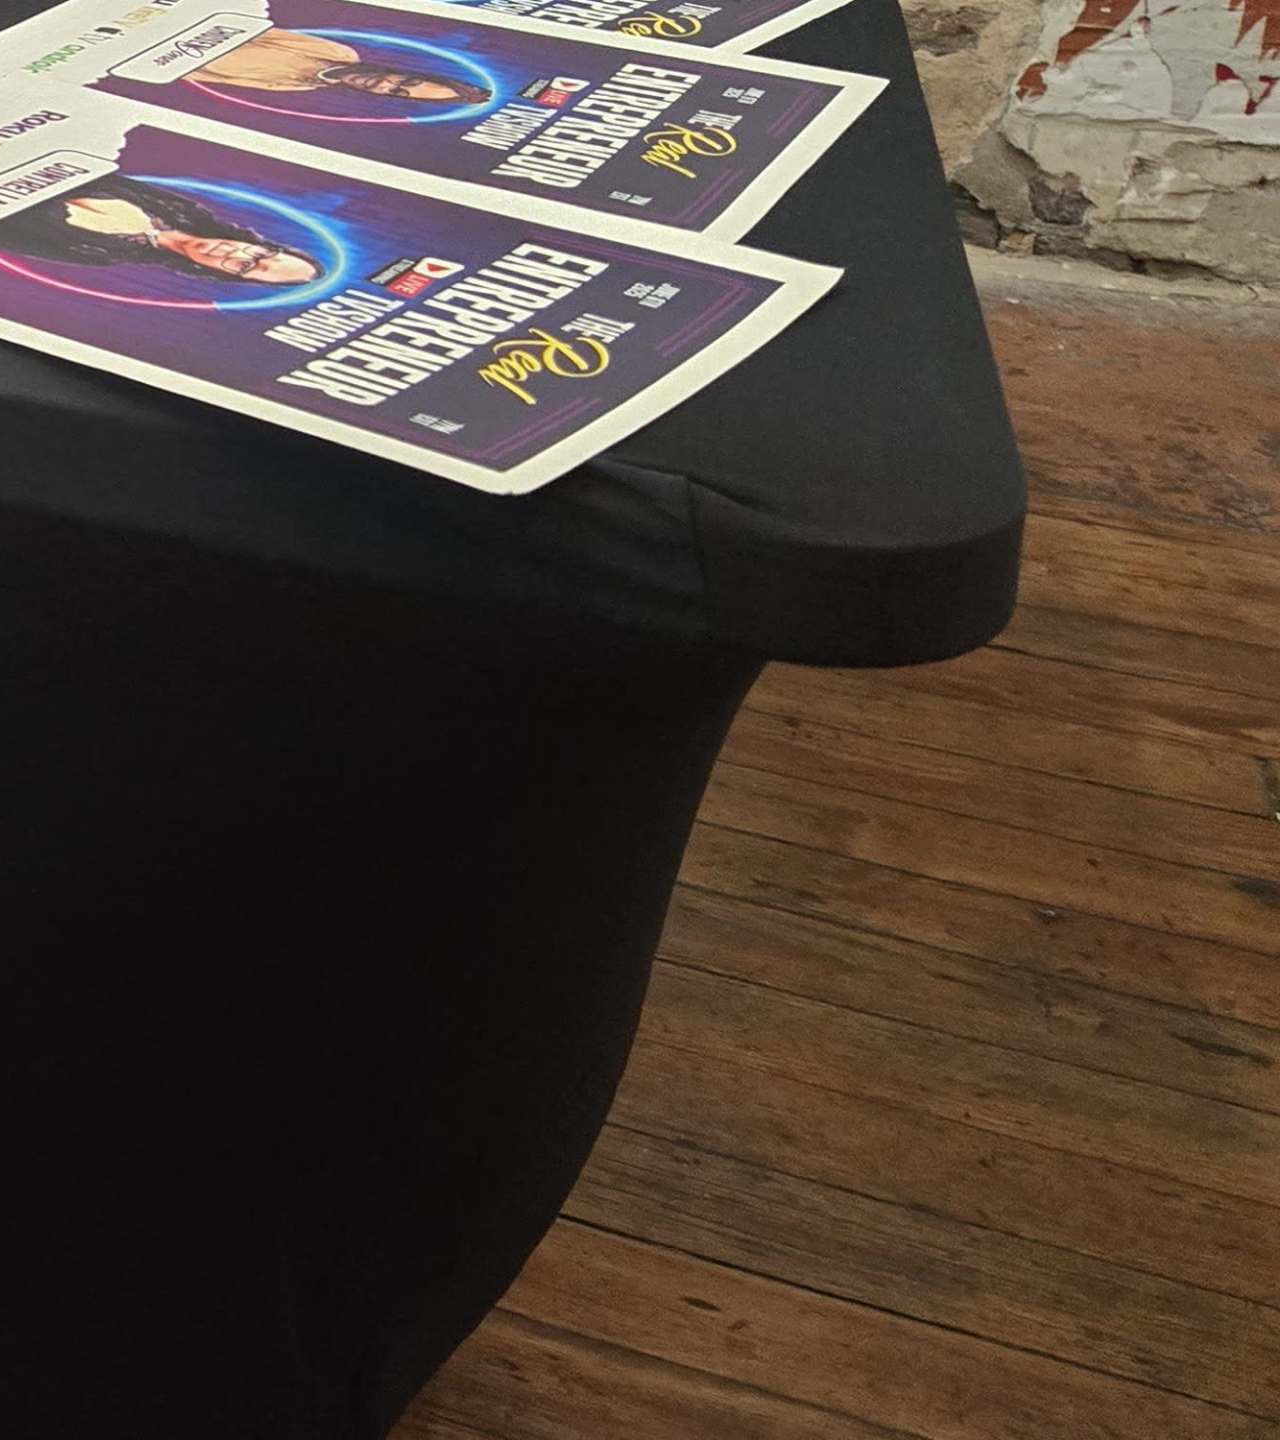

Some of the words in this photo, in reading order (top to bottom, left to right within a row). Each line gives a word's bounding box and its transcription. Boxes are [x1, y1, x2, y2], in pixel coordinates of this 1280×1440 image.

[457, 102, 557, 150] TVSHOW
[487, 62, 701, 188] ENTREPRENEUR
[686, 109, 743, 130] THE
[640, 121, 738, 178] Real
[390, 273, 433, 295] LIVE
[258, 287, 406, 354] TVSHOW
[273, 242, 610, 409] ENTREPRENEUR
[557, 311, 636, 344] THE
[478, 326, 610, 406] Real
